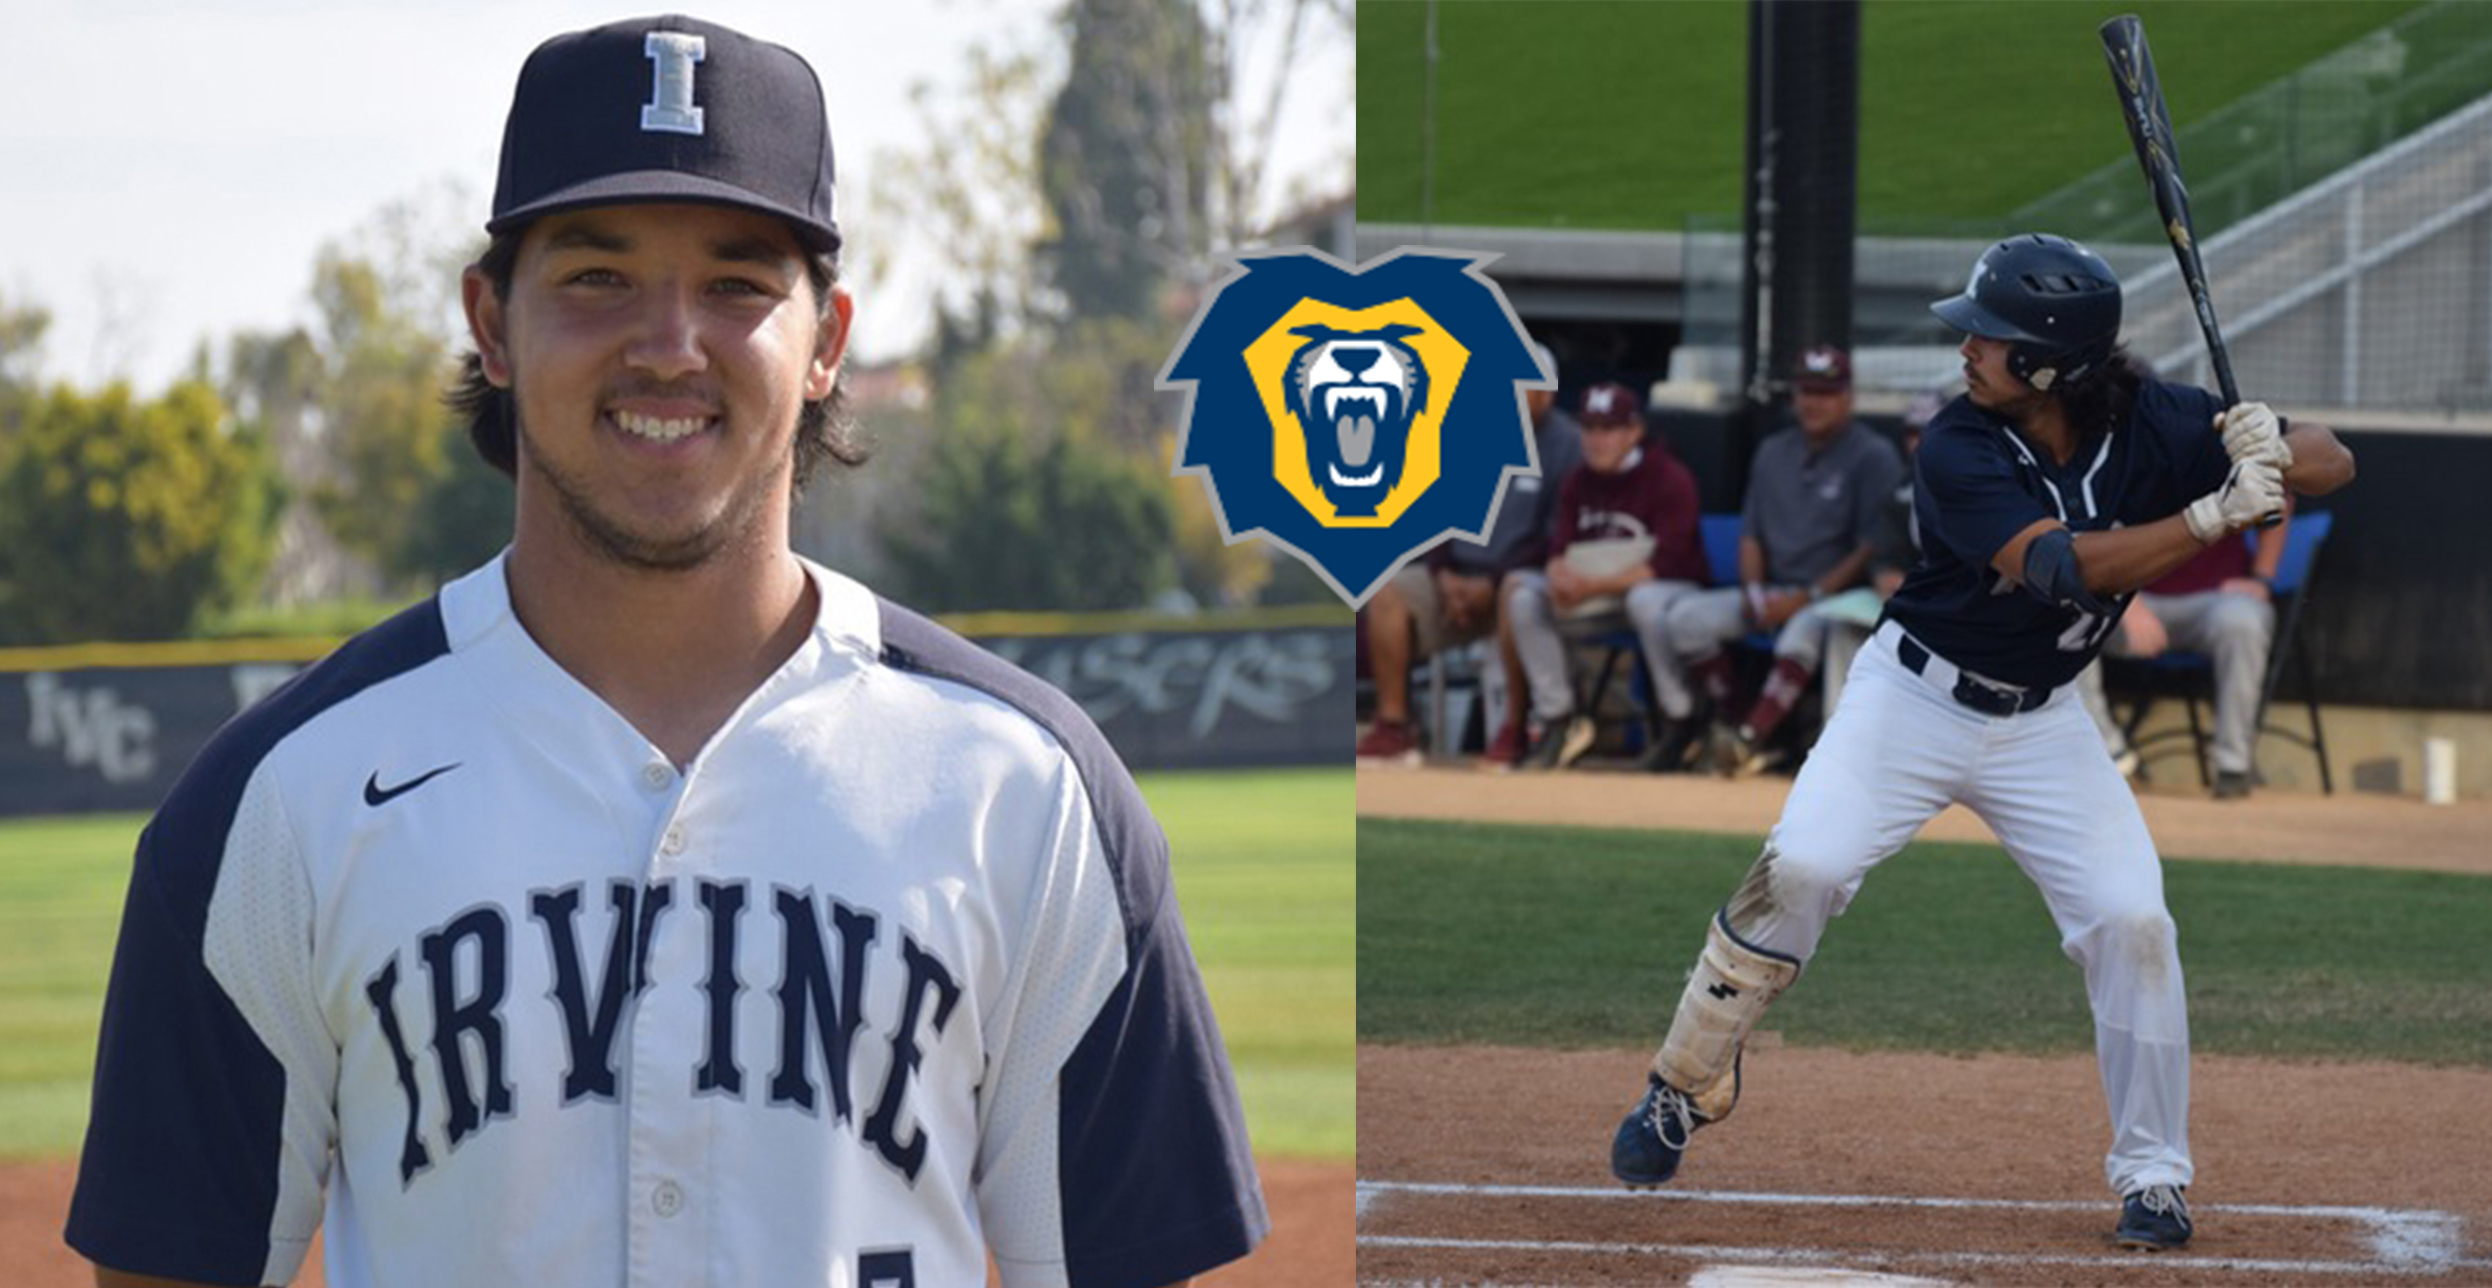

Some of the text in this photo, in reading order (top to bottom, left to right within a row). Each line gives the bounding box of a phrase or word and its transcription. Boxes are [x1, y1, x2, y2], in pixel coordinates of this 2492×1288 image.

[641, 31, 706, 135] I
[25, 669, 157, 782] IVC
[365, 876, 963, 1191] IRVINE
